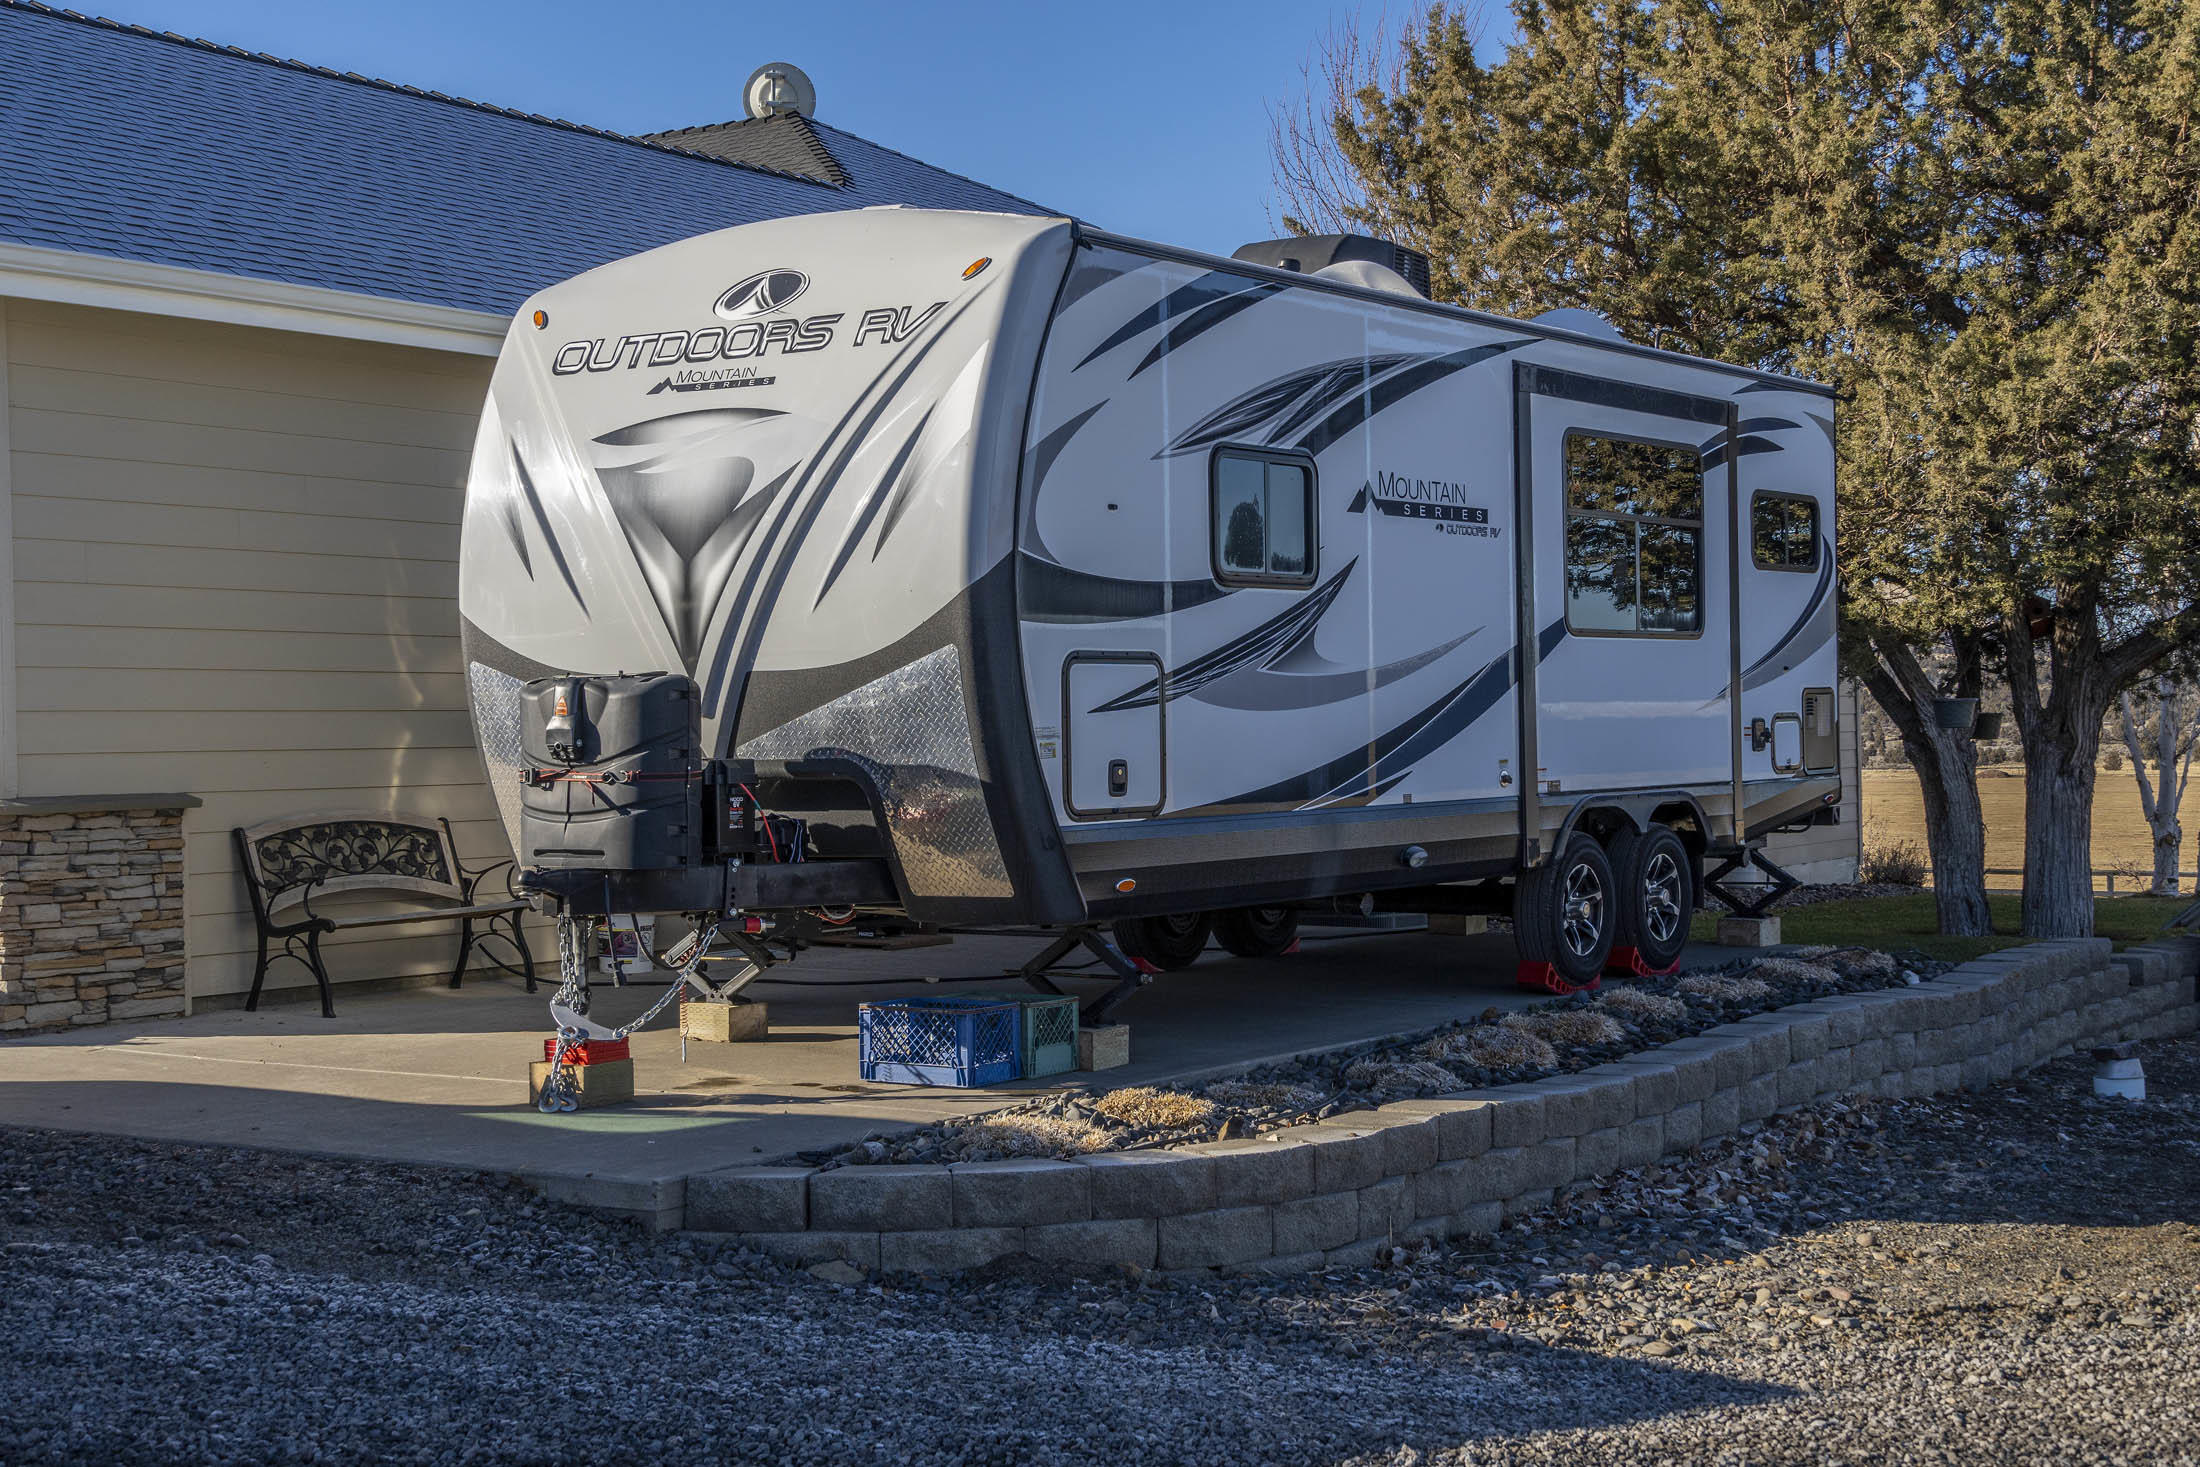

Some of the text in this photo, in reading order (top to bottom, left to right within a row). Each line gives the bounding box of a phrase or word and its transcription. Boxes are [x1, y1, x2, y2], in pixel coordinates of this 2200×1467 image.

[552, 301, 951, 376] OUTDOORS RV
[676, 366, 757, 384] MOUNTAIN
[695, 377, 771, 392] SERIES
[1378, 470, 1466, 504] MOUNTAIN
[1403, 504, 1483, 521] SERIES
[1446, 524, 1488, 537] OUTDOORS
